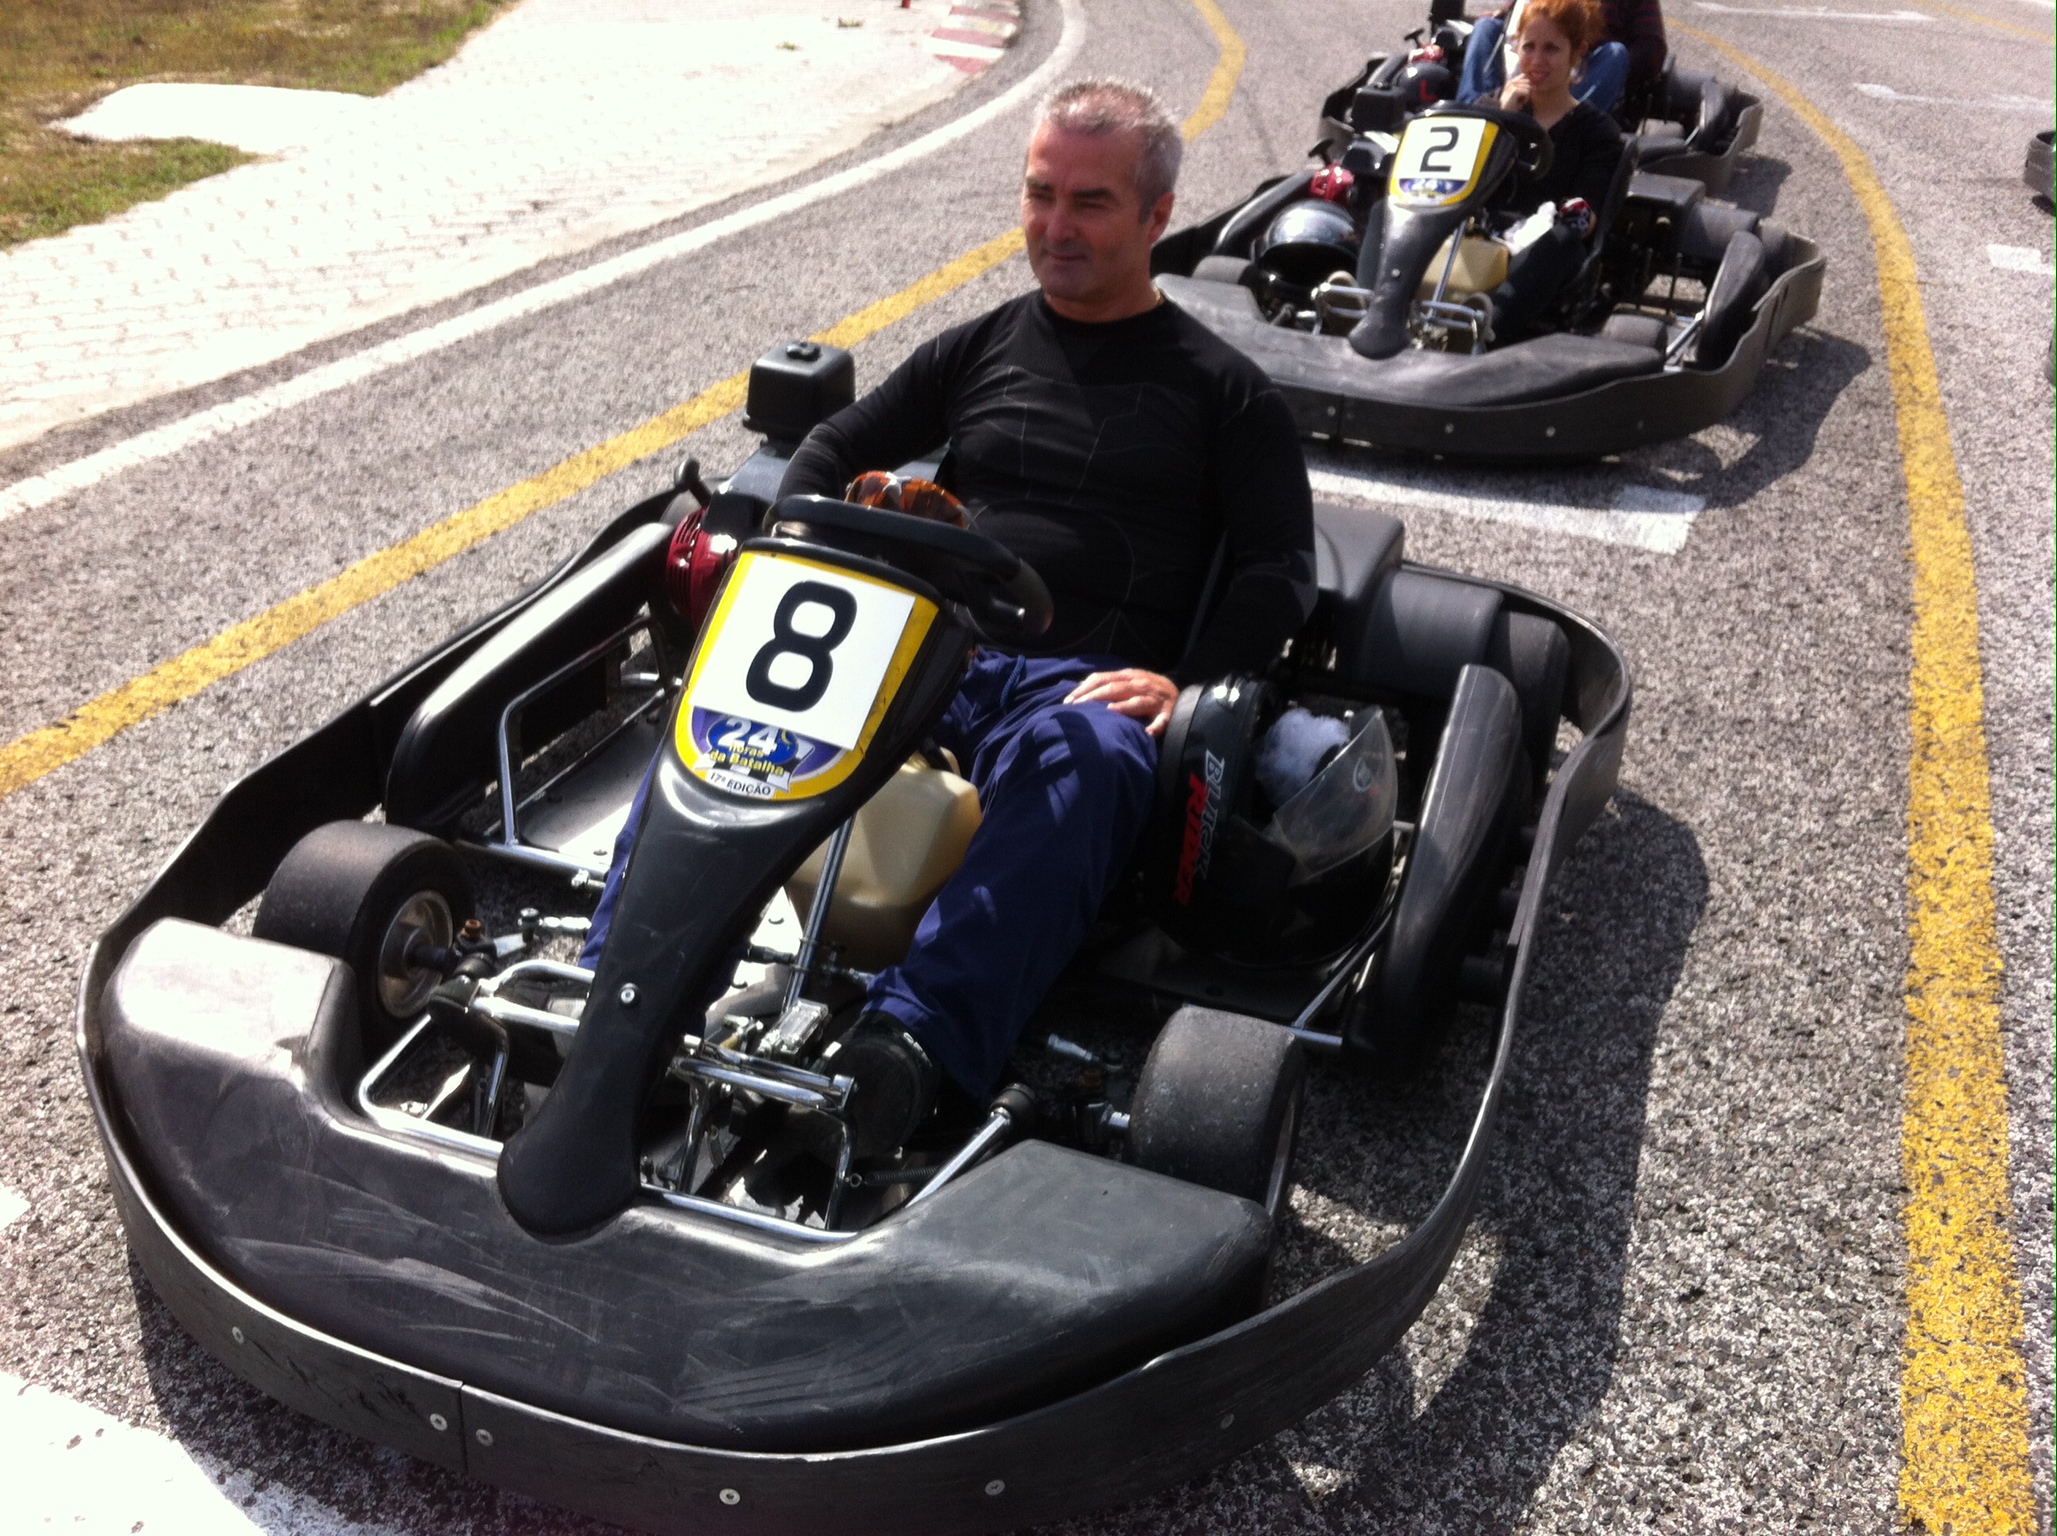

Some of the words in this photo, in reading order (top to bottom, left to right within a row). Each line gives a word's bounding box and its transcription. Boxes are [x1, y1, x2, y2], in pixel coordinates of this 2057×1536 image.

[1419, 125, 1460, 173] 2
[746, 580, 857, 713] 8
[718, 717, 780, 756] 24
[710, 750, 726, 762] da
[729, 752, 784, 776] Batalha
[727, 778, 771, 796] EDIÇÃO
